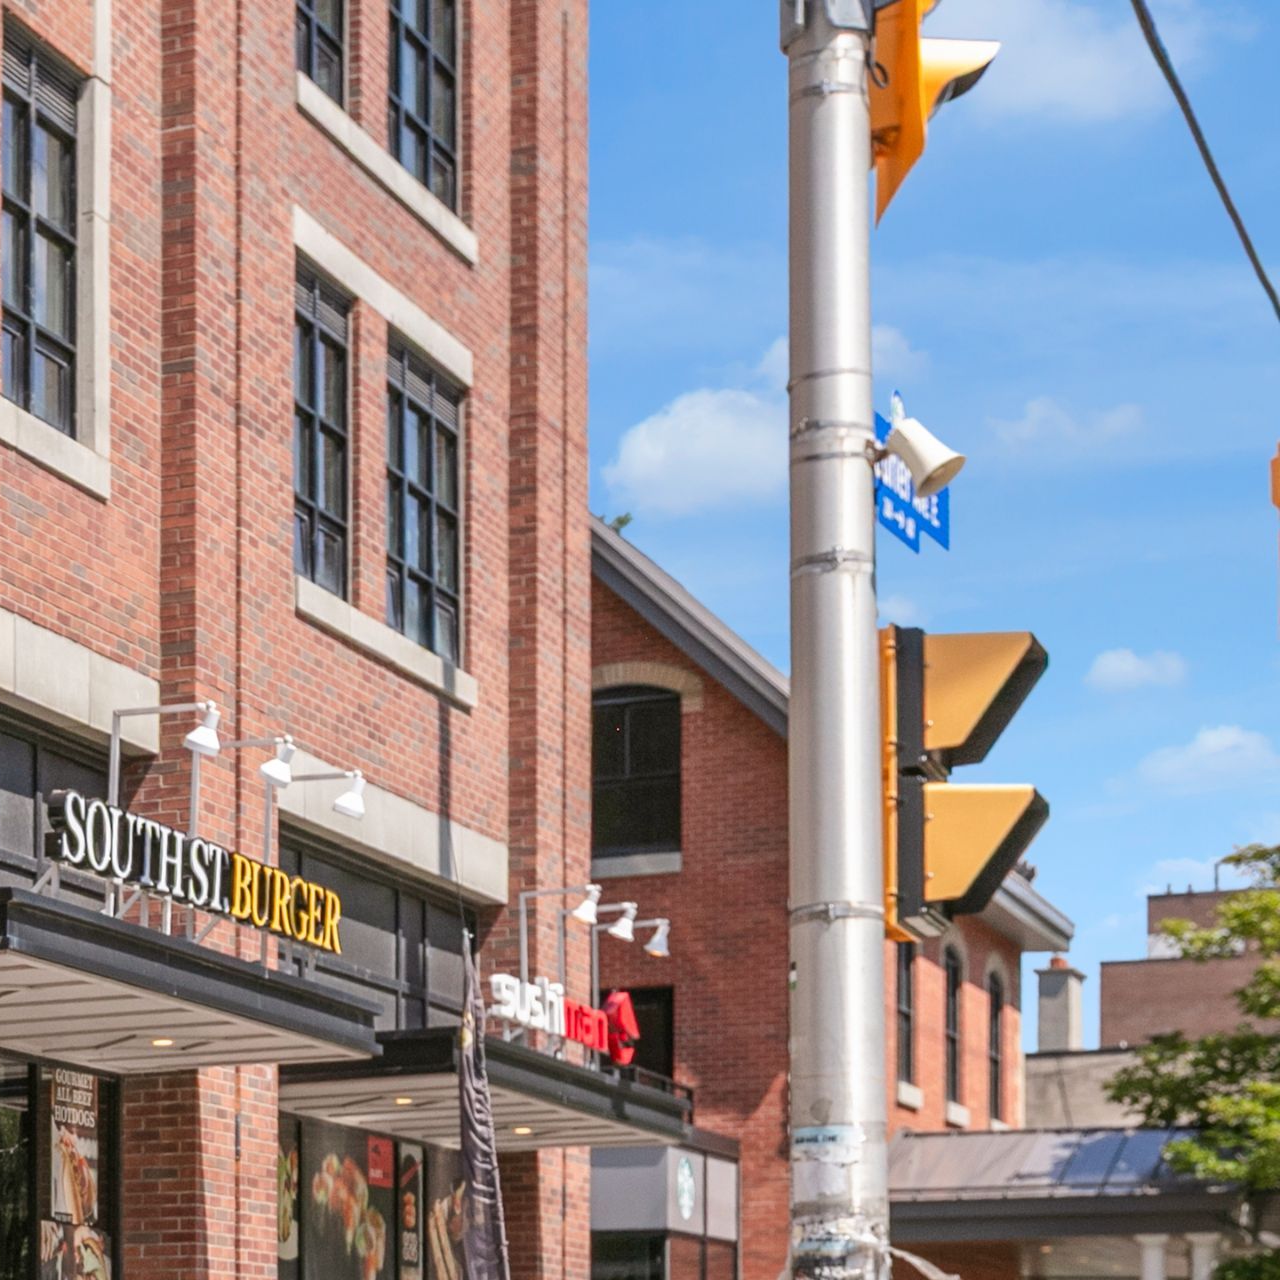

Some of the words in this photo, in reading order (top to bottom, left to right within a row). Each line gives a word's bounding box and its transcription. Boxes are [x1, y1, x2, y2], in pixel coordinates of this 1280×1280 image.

[62, 791, 187, 898] SOUTH
[231, 852, 342, 955] BURGER
[488, 973, 609, 1055] sushiman
[55, 1068, 94, 1090] GOURMET
[56, 1086, 71, 1103] ALL
[72, 1089, 93, 1107] BEEF
[54, 1104, 95, 1128] HOTDOGS
